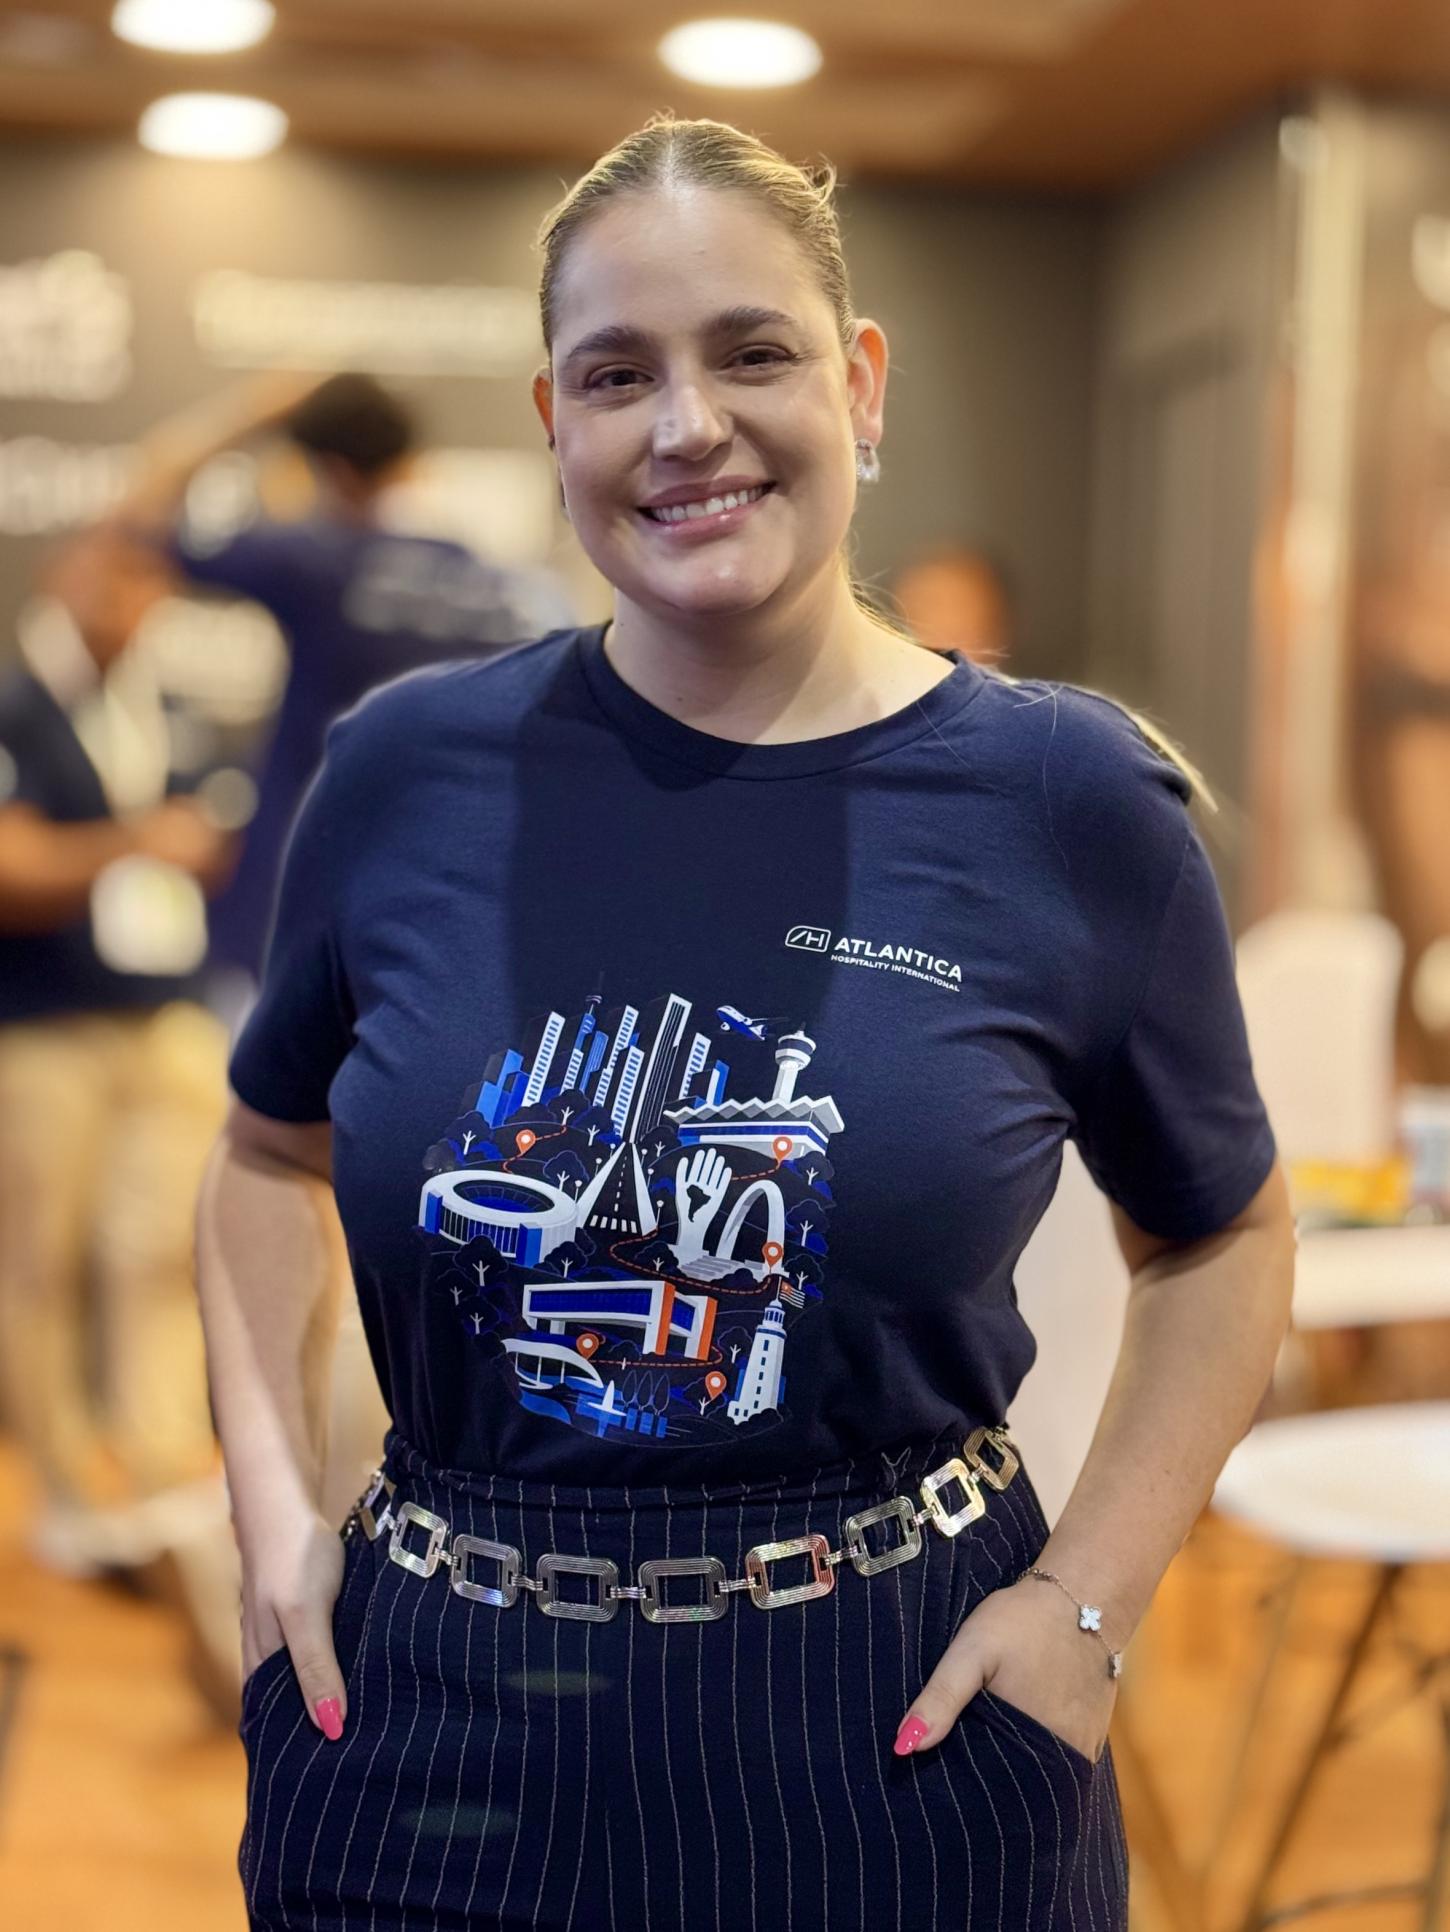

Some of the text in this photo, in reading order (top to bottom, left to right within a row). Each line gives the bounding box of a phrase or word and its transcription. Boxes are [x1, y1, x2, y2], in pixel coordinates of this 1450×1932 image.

[831, 954, 960, 992] HOSPITALITY INTERNATIONAL
[834, 937, 962, 982] ATLANTICA
